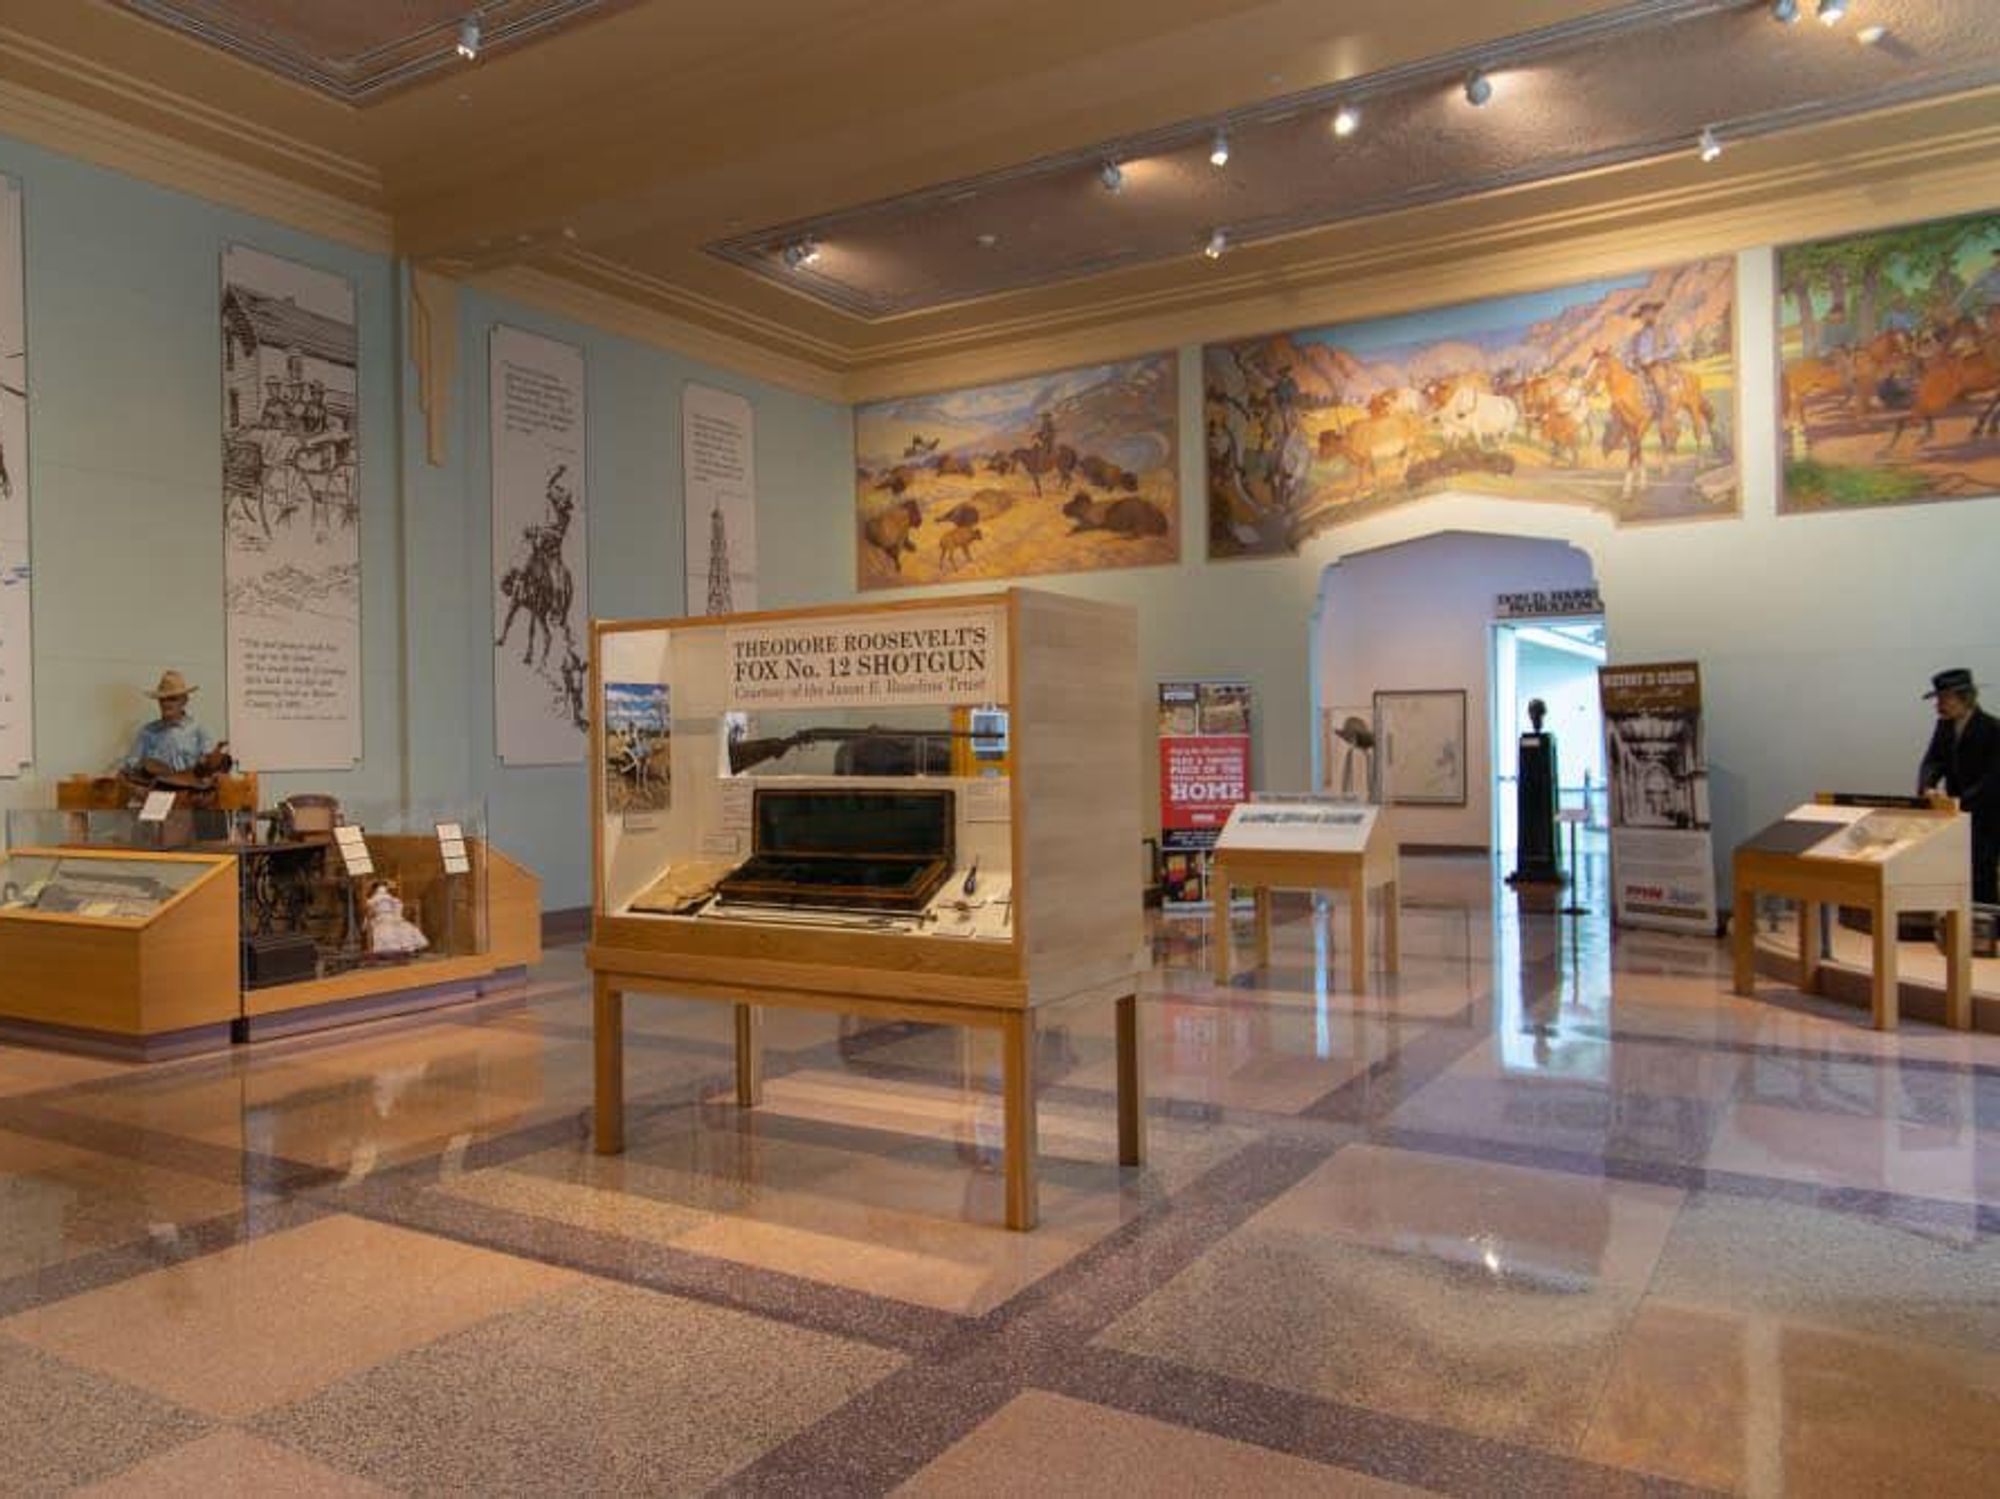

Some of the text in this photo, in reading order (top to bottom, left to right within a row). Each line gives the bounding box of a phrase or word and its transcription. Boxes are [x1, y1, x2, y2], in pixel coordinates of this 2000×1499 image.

[734, 627, 987, 659] THEODORE ROOSEVELT'S
[735, 651, 987, 683] FOX No. 12 SHOTGUN
[734, 683, 785, 701] Courtesy
[1170, 782, 1245, 801] HOME
